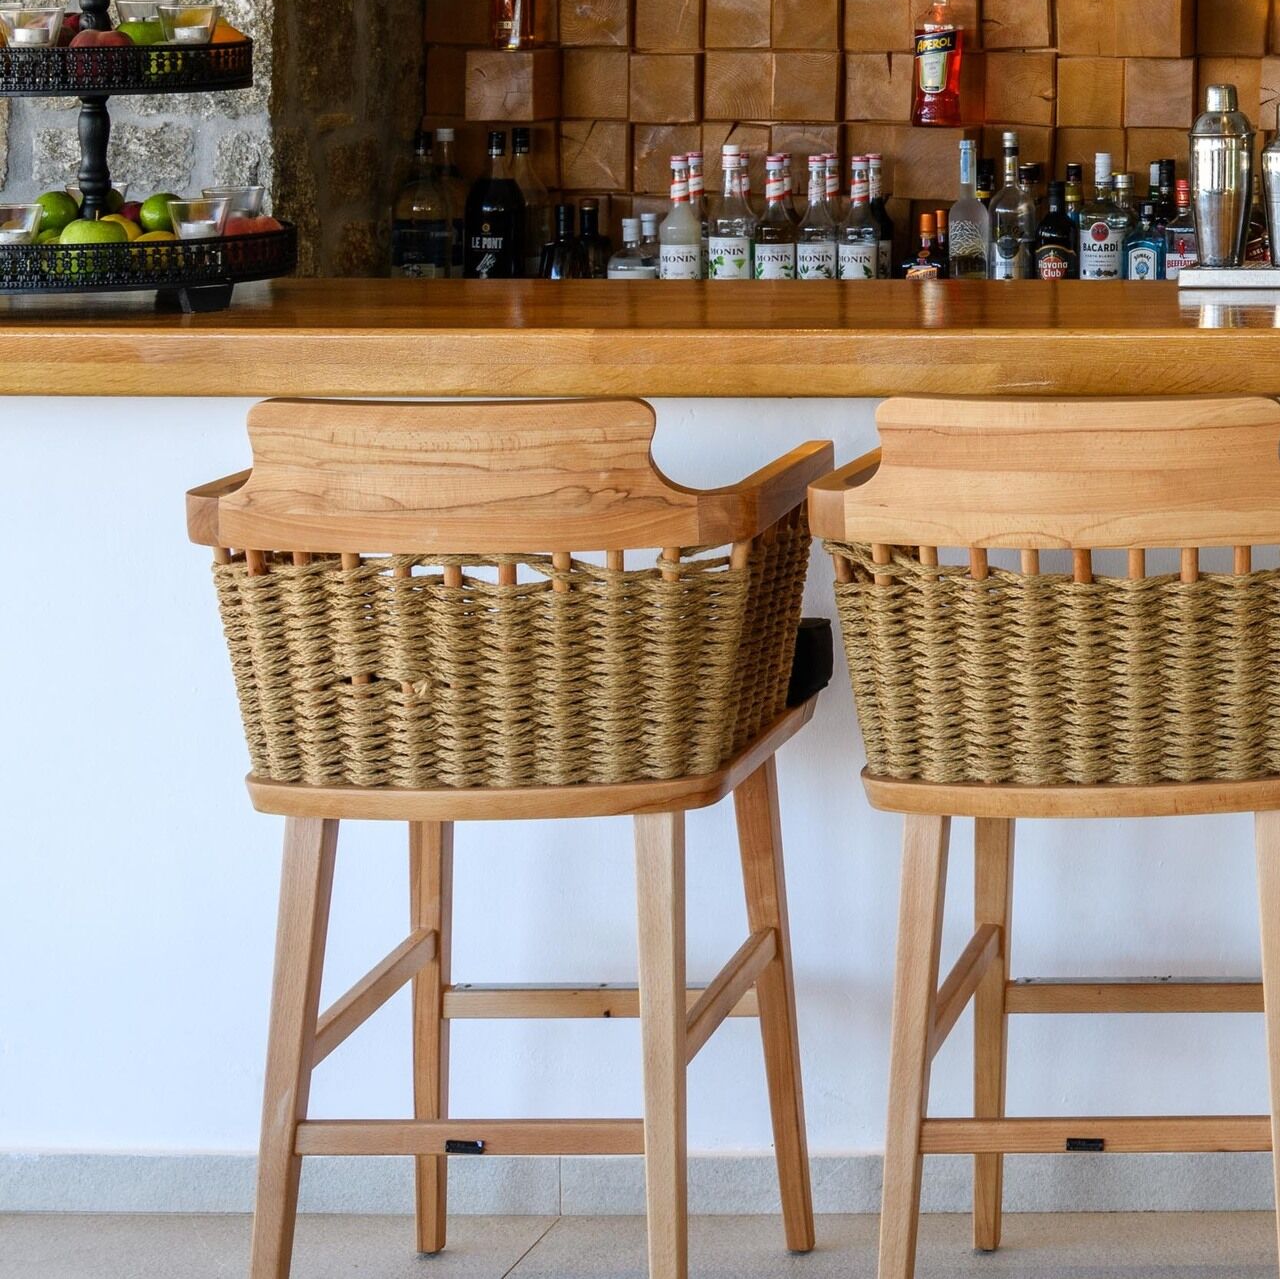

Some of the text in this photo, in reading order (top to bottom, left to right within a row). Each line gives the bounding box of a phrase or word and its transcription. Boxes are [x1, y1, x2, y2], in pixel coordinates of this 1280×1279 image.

[917, 38, 952, 53] APEROL
[471, 237, 503, 249] LE PONT
[1083, 241, 1119, 252] BACARDÍ
[662, 255, 697, 263] MONIN
[1038, 260, 1068, 269] Havana
[1043, 270, 1062, 278] Club
